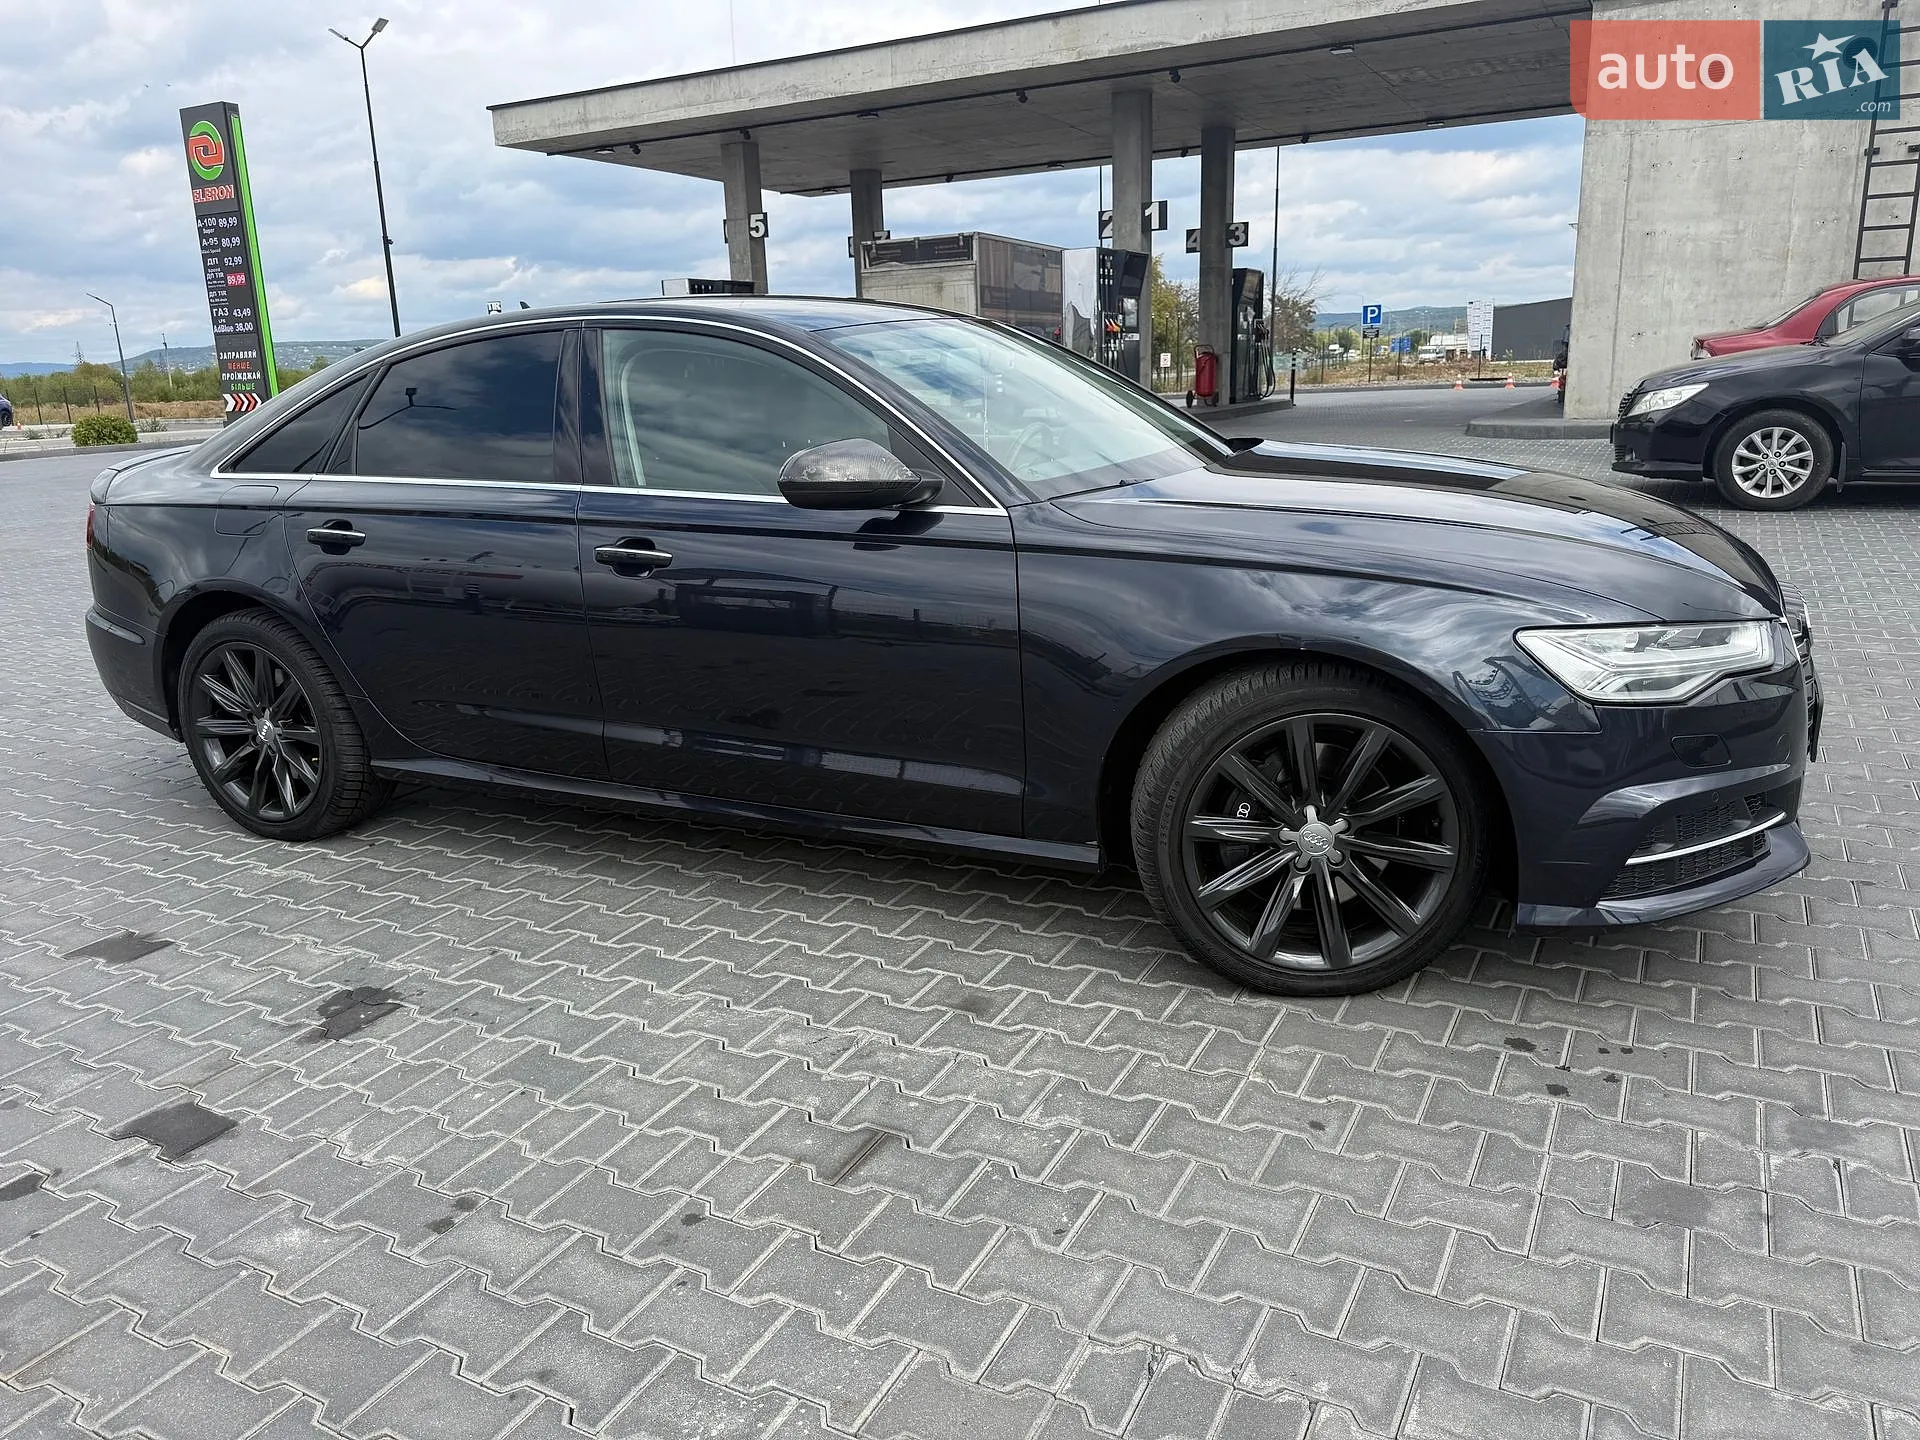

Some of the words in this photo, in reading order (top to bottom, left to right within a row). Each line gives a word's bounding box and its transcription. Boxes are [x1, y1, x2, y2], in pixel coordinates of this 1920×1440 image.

[192, 185, 235, 203] ELERON
[218, 216, 238, 228] 89,99
[1145, 202, 1160, 231] 1
[750, 213, 765, 238] 5
[1228, 223, 1245, 247] 3
[1187, 232, 1200, 251] 4
[207, 257, 218, 266] ДП
[224, 256, 242, 267] 92,99
[213, 307, 229, 317] ГАЗ
[232, 307, 251, 318] 43,49
[1367, 306, 1379, 324] P
[213, 324, 234, 333] AdBlue
[235, 321, 253, 332] 38,00
[220, 349, 257, 360] ЗАПРАВЛЯЙ
[221, 370, 261, 381] ПРОЇЖДЖАЙ
[231, 382, 256, 391] БІЛЬШЕ
